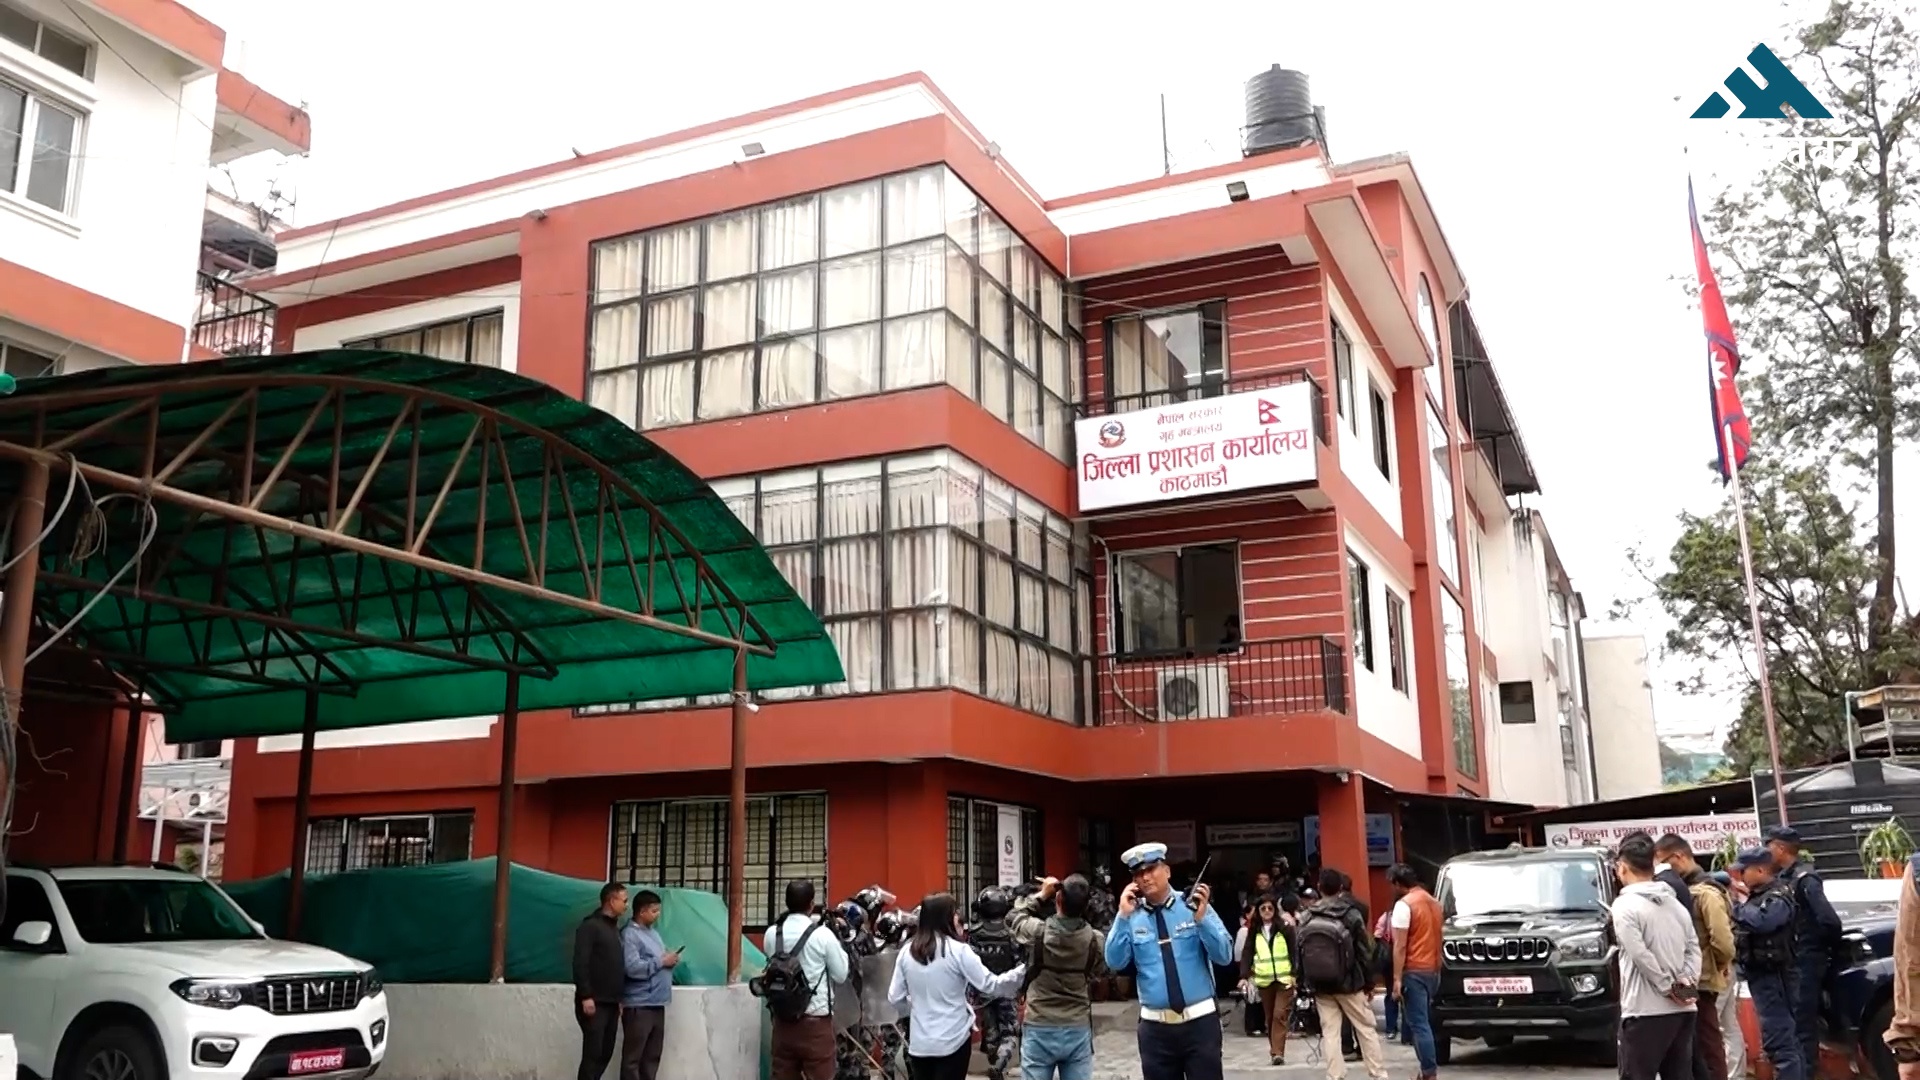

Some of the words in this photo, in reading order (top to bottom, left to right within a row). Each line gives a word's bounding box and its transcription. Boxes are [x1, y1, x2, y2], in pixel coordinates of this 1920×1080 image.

[1157, 411, 1184, 426] नेपाल
[1189, 406, 1223, 421] सरकार
[1159, 429, 1175, 444] गृह
[1178, 423, 1223, 439] मन्त्रालय
[1083, 453, 1141, 482] जिल्ला
[1147, 441, 1215, 476] प्रशासन
[1222, 428, 1308, 461] कार्यालय
[1662, 821, 1718, 836] कार्यालय
